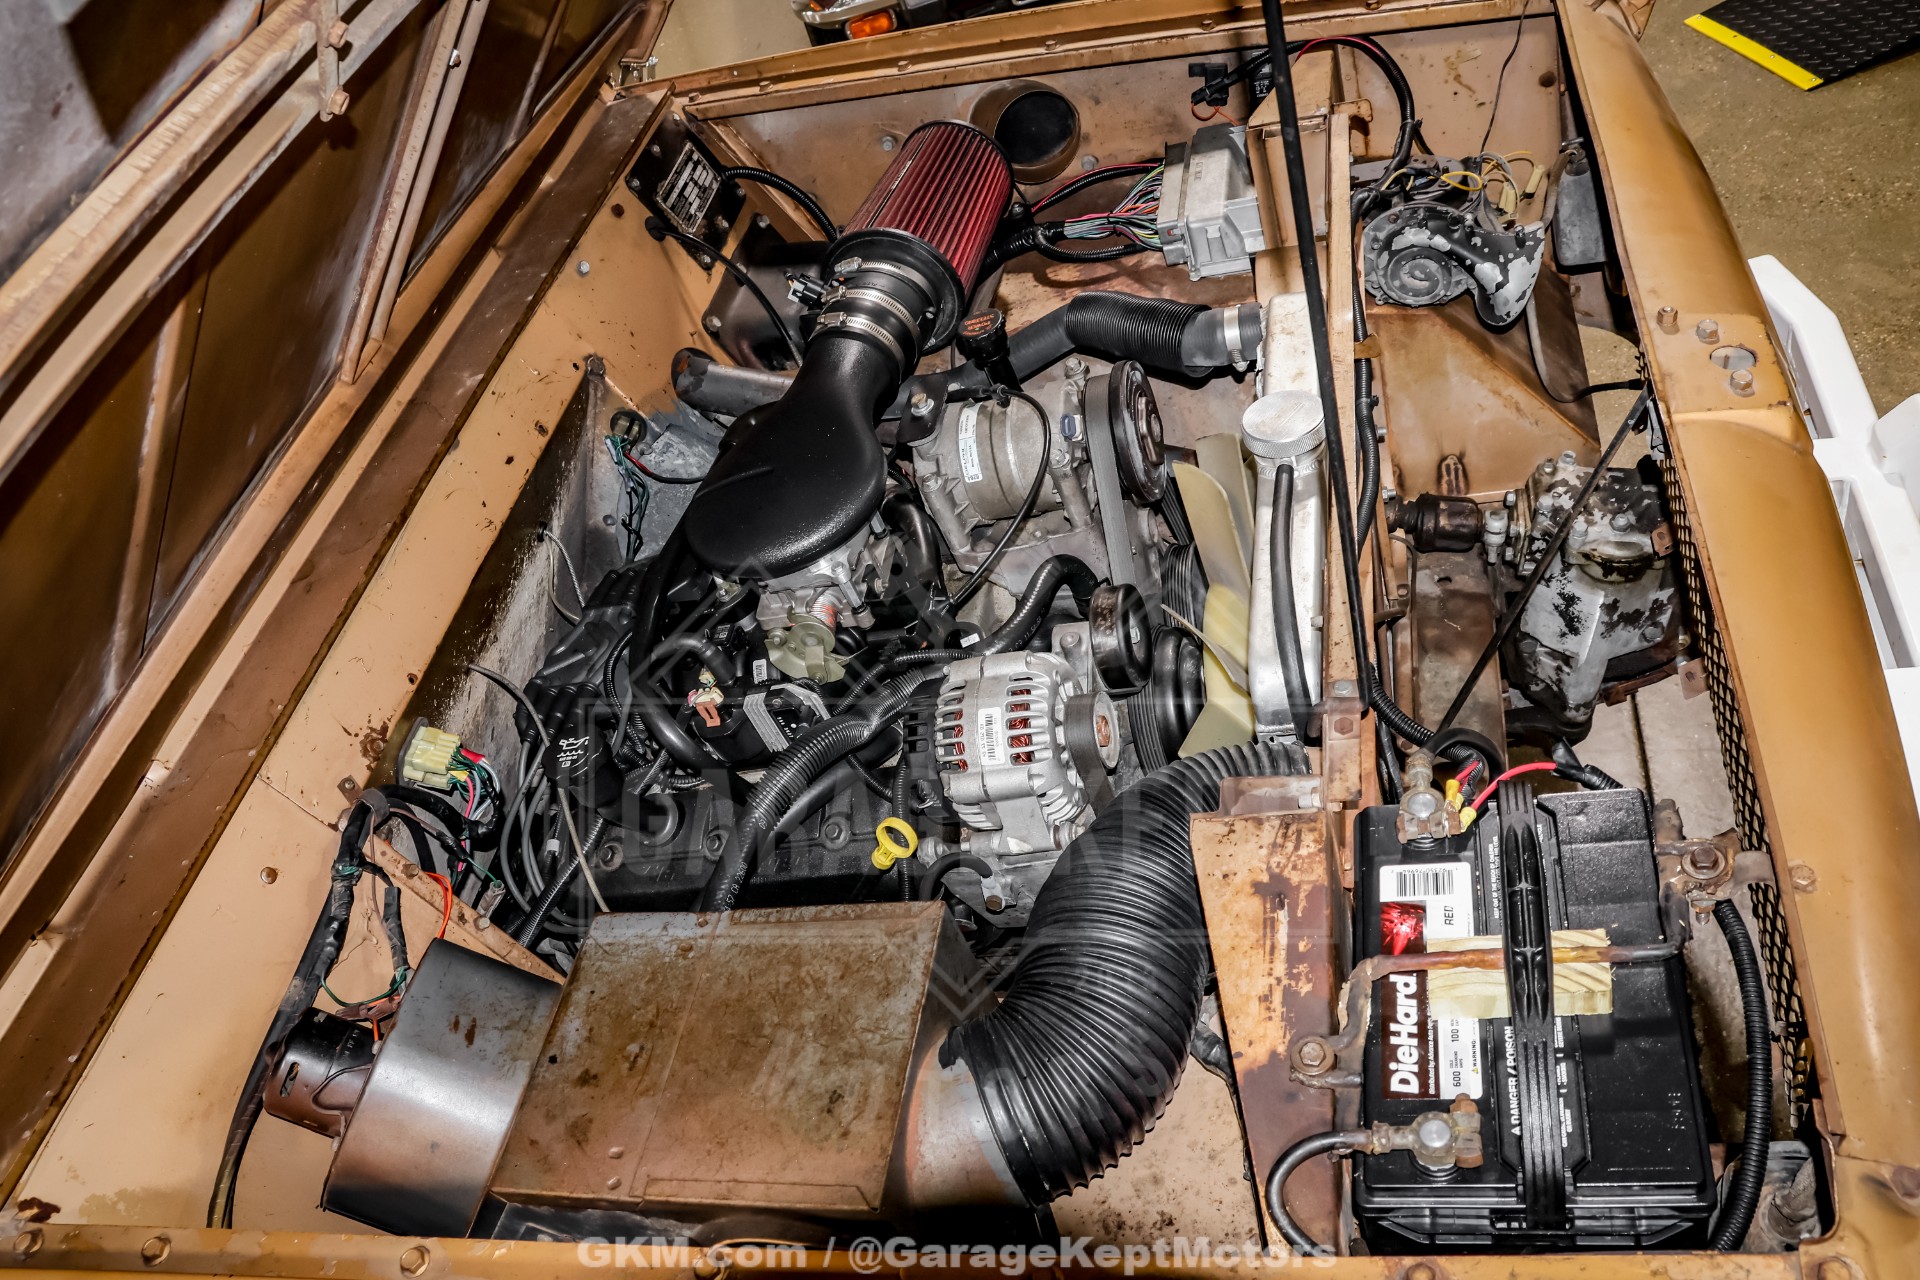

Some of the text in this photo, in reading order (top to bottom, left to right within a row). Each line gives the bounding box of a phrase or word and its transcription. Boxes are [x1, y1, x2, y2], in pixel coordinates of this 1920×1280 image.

[1443, 906, 1455, 926] RED
[1450, 1028, 1459, 1043] 100
[1505, 1026, 1515, 1067] POISON
[1452, 1071, 1461, 1088] 600
